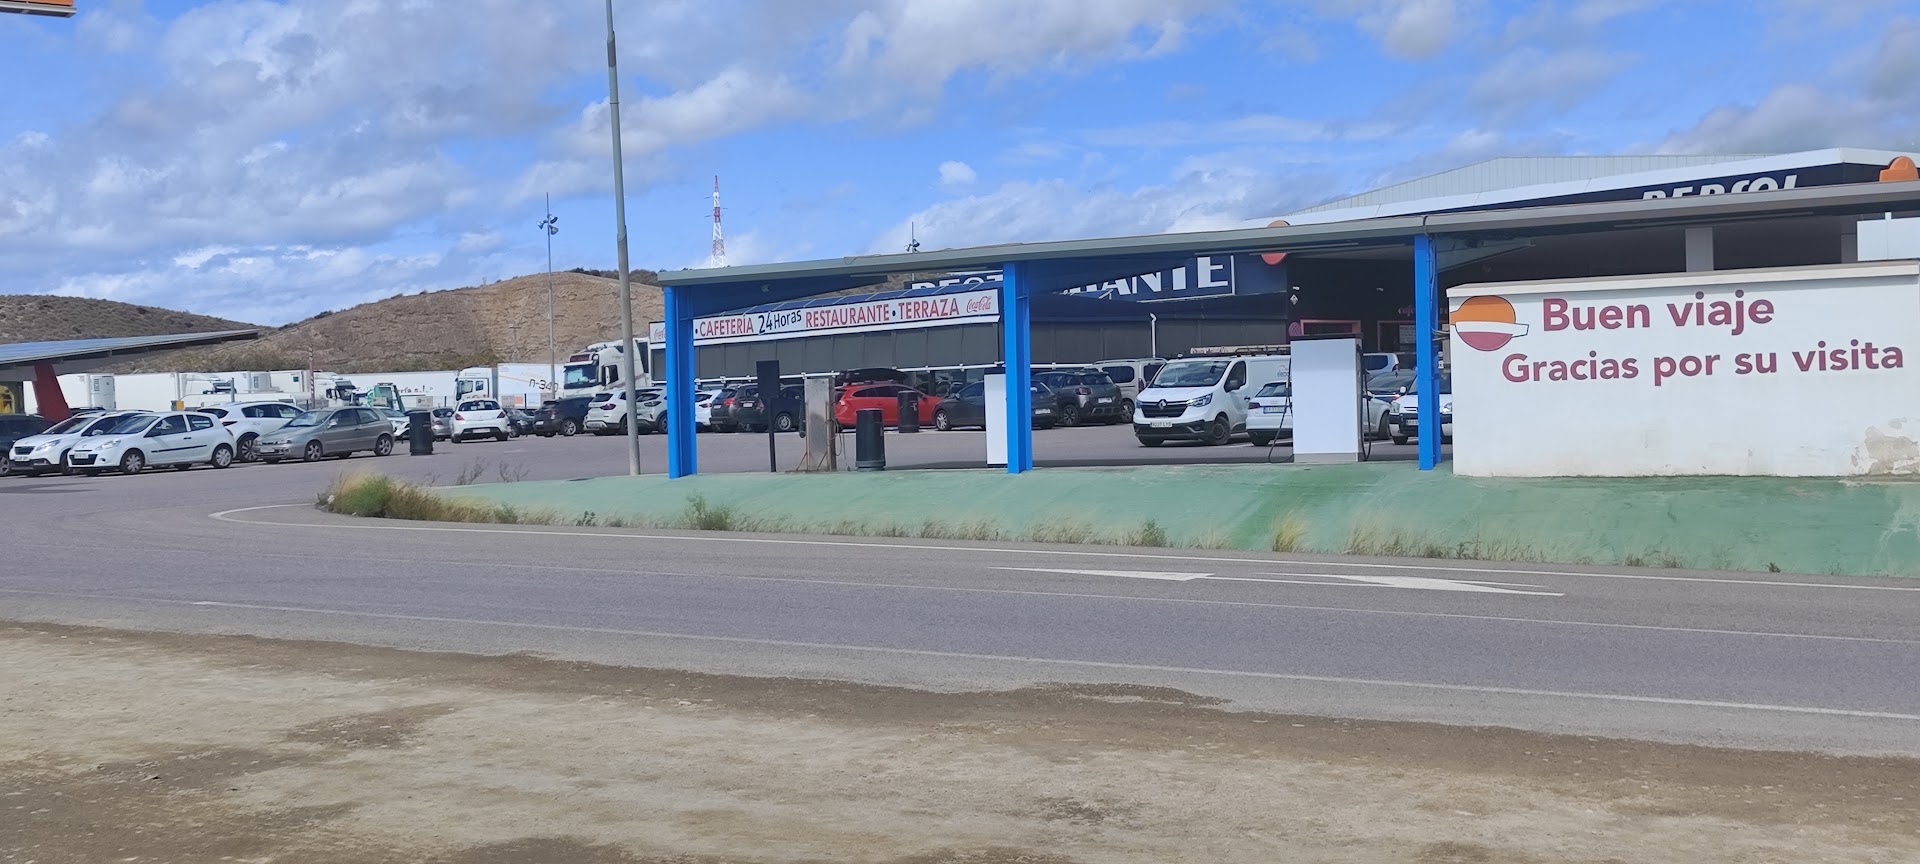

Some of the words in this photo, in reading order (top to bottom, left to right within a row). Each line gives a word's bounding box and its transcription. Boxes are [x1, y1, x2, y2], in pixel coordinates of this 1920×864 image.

[805, 303, 890, 328] RESTAURANTE
[898, 297, 960, 320] TERRAZA
[1543, 297, 1650, 332] Buen
[1668, 290, 1775, 336] viaje
[1502, 351, 1638, 382] Gracias
[1653, 353, 1721, 386] por
[1734, 352, 1778, 375] su
[1793, 339, 1903, 372] visita
